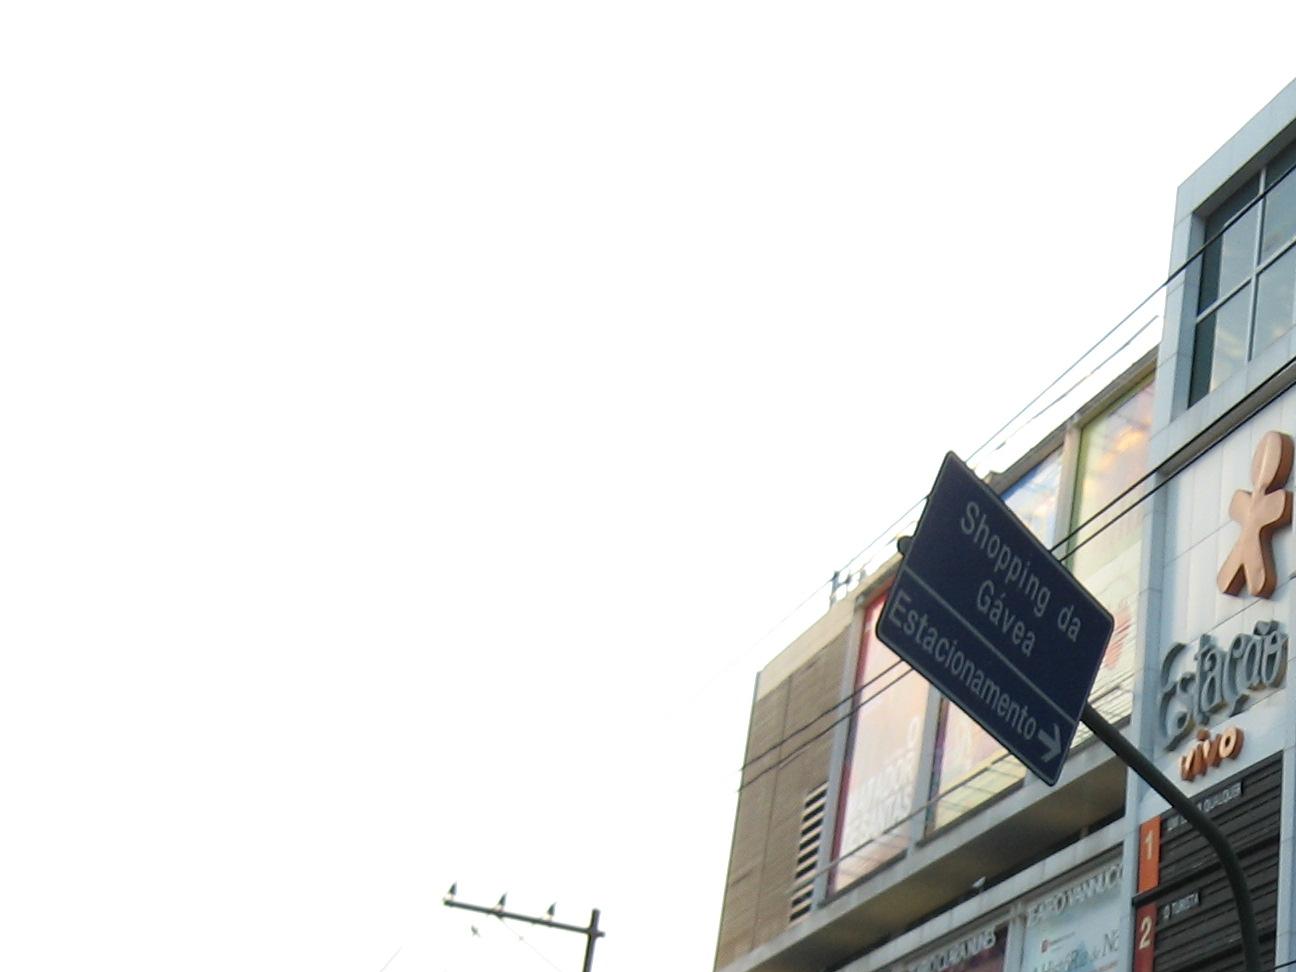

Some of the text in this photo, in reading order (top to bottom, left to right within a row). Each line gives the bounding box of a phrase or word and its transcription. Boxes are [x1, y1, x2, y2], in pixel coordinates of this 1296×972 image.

[961, 501, 1082, 642] Shopping da
[976, 579, 1037, 657] Gávea
[888, 590, 1038, 741] Estacionamento
[1144, 829, 1154, 861] 1
[1139, 915, 1152, 951] 2
